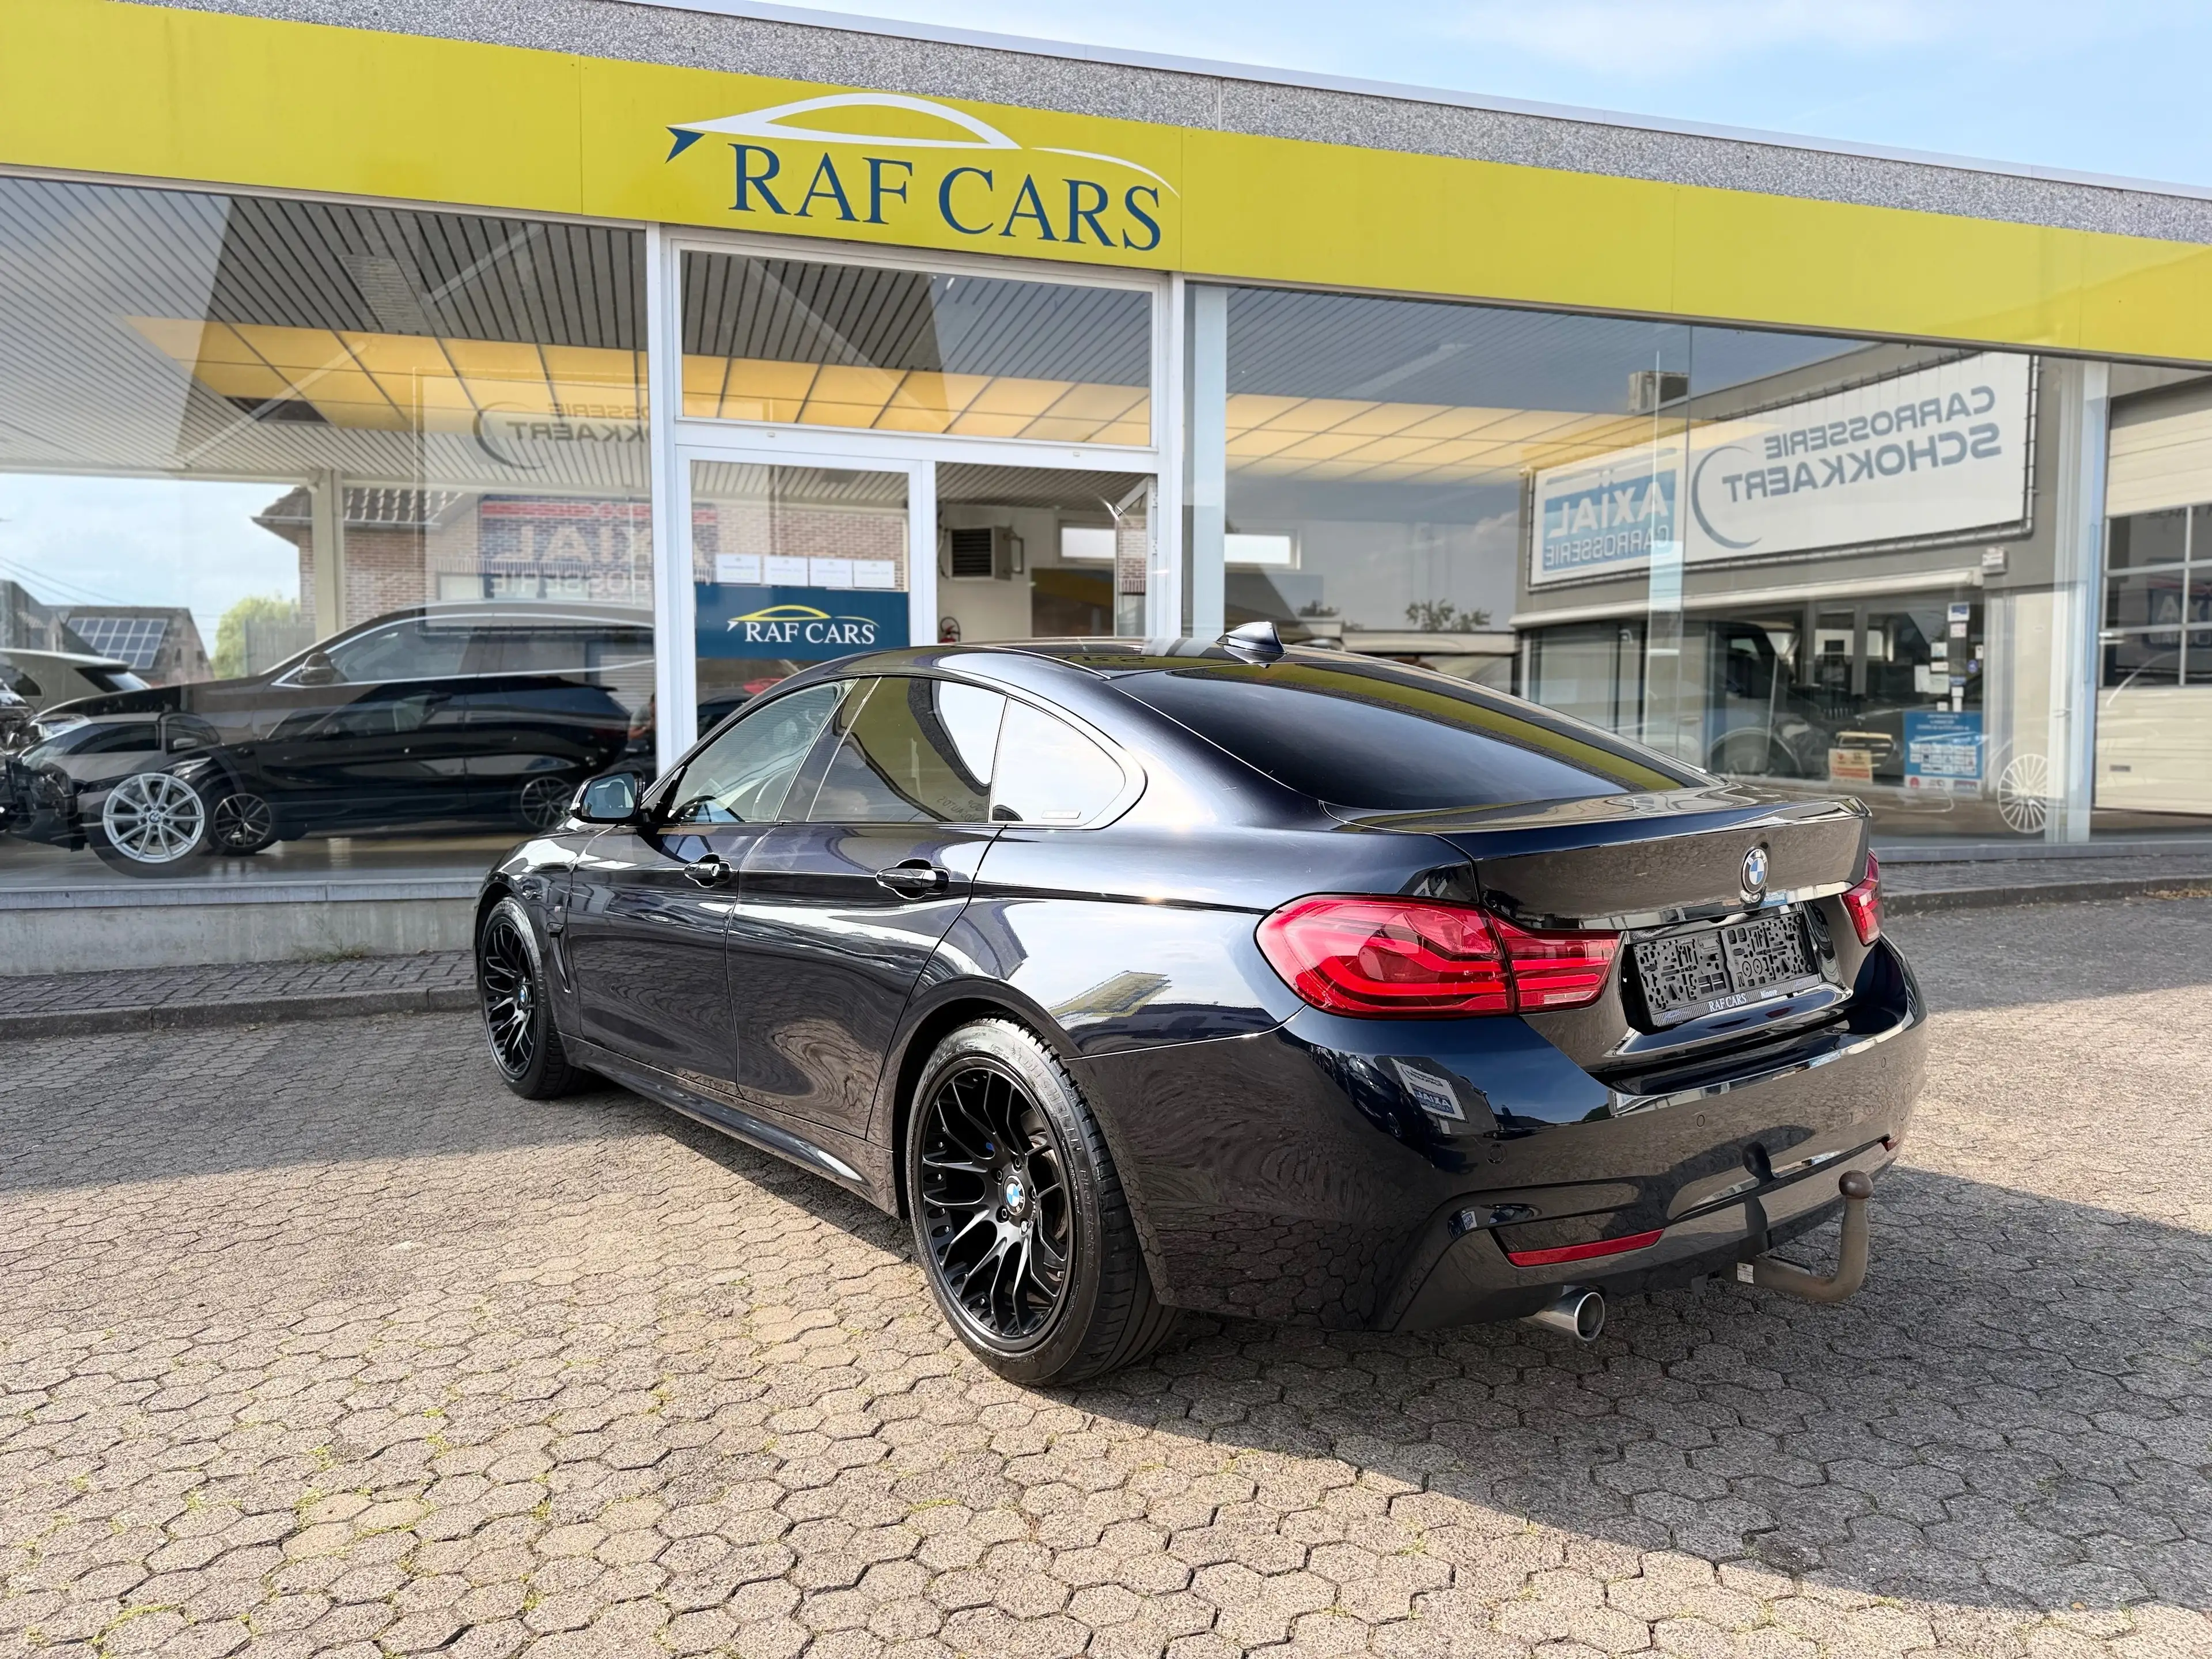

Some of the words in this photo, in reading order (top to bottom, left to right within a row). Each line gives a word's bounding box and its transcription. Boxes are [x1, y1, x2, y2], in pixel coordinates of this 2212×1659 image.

[727, 143, 913, 225] RAF
[938, 166, 1161, 251] CARS
[744, 622, 800, 643] RAF
[805, 623, 876, 645] CARS
[1708, 998, 1725, 1013] RAF
[1726, 993, 1747, 1007] CARS
[1760, 989, 1778, 999] Ninove
